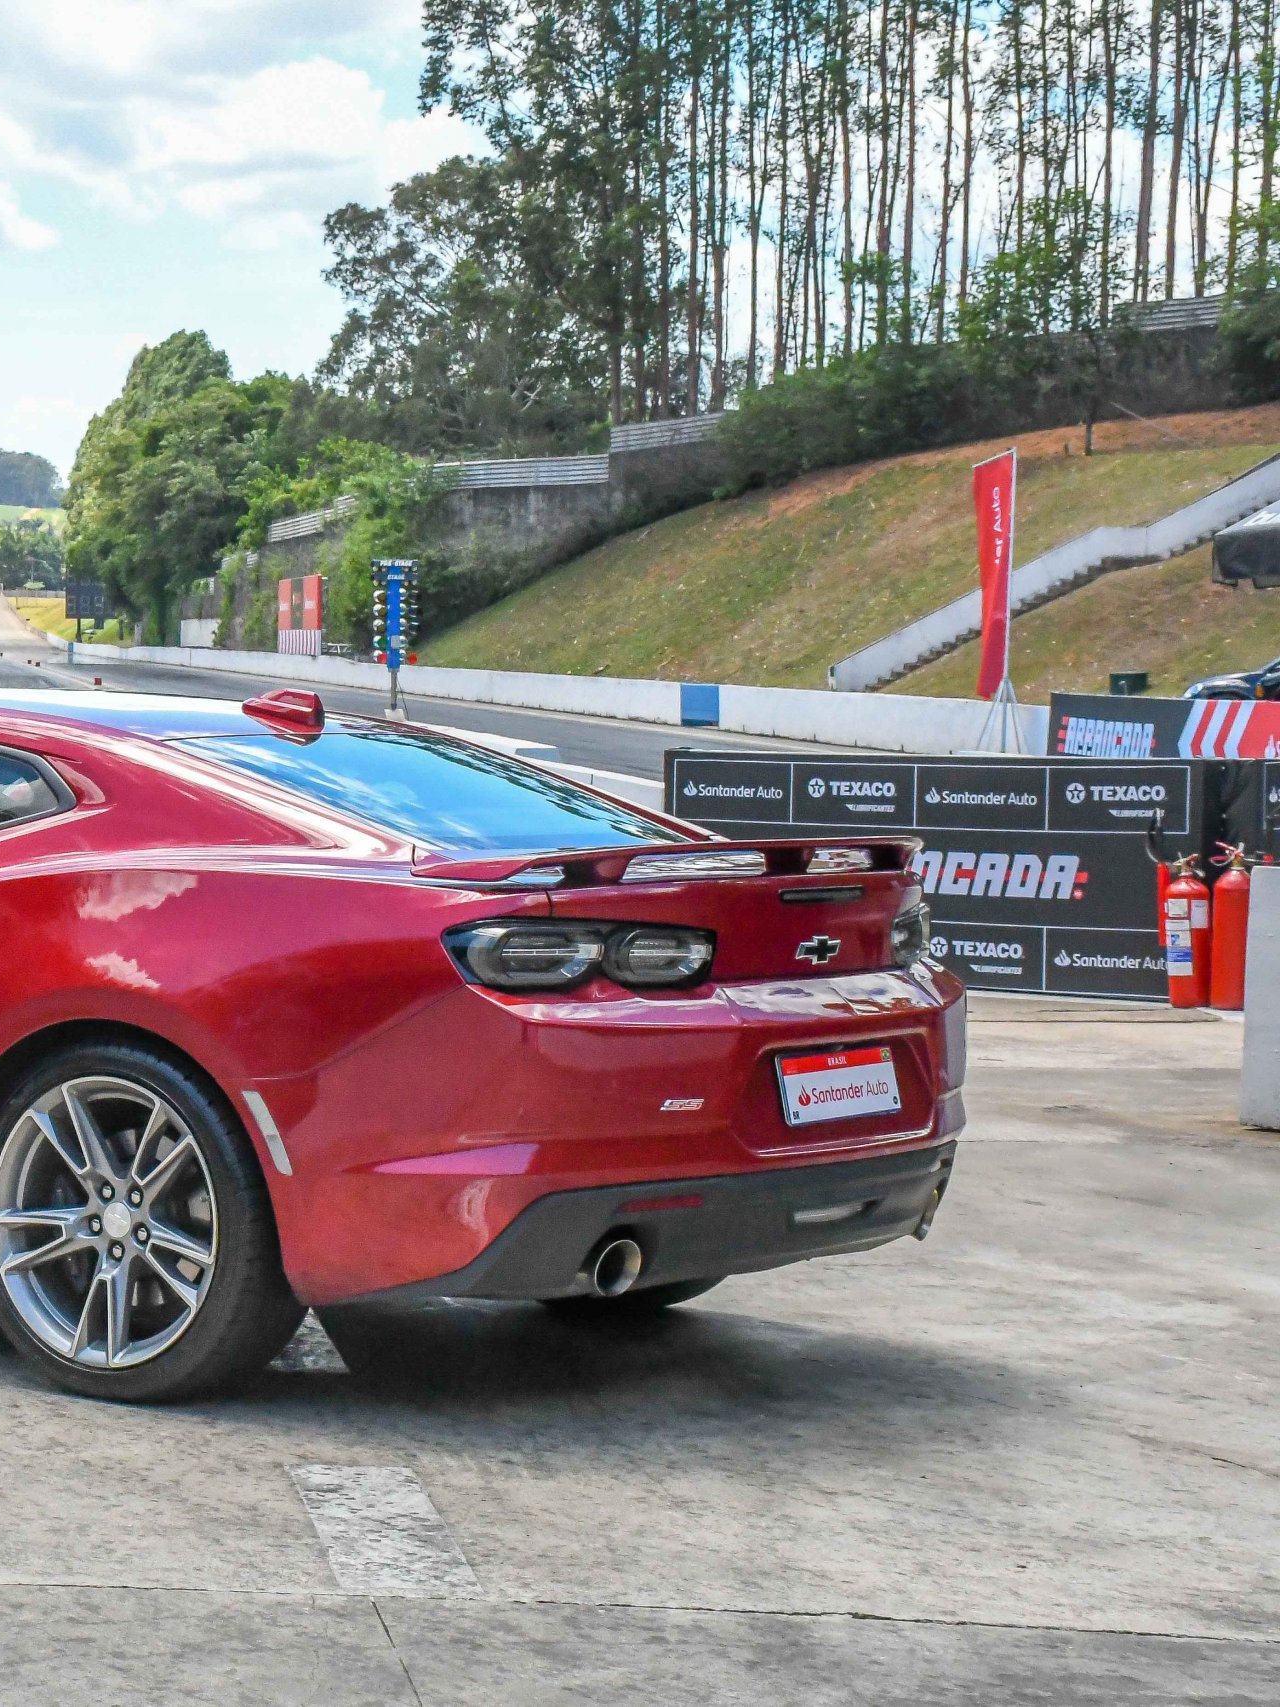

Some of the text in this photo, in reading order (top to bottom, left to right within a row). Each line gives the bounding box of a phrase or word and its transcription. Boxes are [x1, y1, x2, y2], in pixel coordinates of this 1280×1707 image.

[698, 782, 784, 800] Santander Auto
[829, 781, 896, 797] TEXACO
[941, 789, 1038, 807] Santander Auto
[1090, 785, 1166, 801] TEXACO
[951, 940, 1024, 959] TEXACO
[1072, 952, 1169, 971] Santander Aut
[826, 1055, 848, 1067] BRASIL
[811, 1080, 890, 1105] Santander Auto
